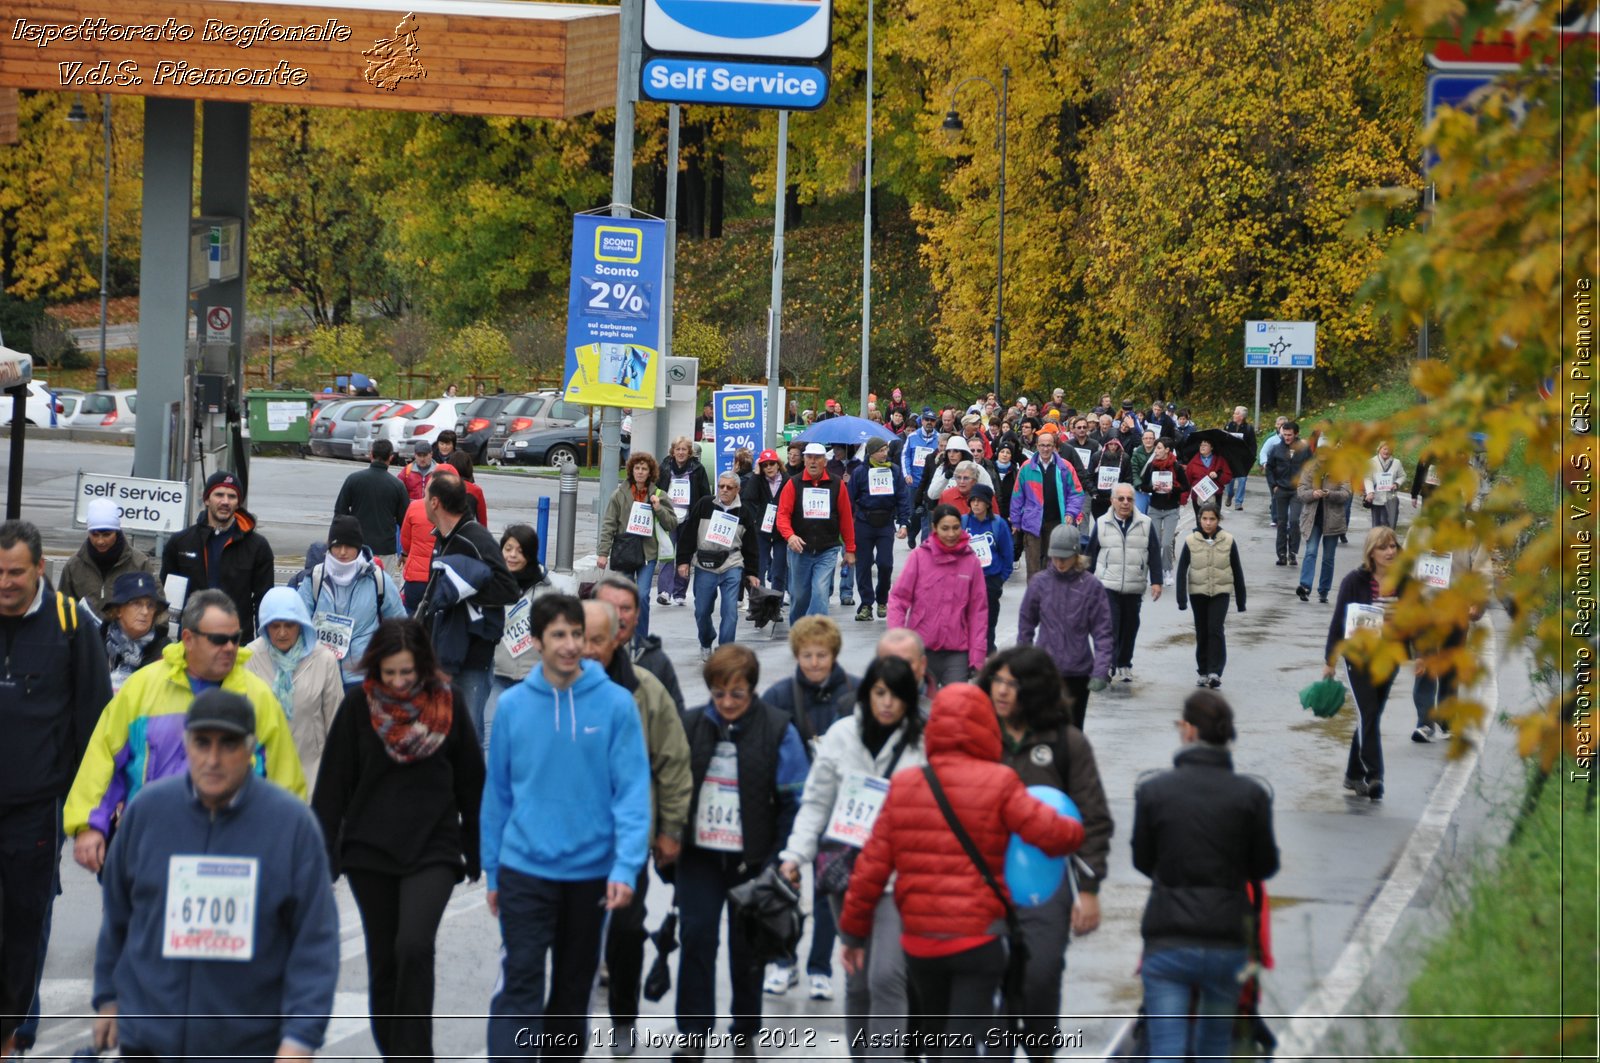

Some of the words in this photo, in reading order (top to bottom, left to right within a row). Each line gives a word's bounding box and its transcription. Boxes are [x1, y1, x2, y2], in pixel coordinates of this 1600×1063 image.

[650, 65, 706, 90] Self
[711, 68, 817, 96] Service
[603, 237, 634, 248] SCONTI
[595, 264, 639, 277] Sconto
[589, 281, 643, 312] 2%
[600, 323, 637, 331] carburante
[723, 421, 756, 430] Sconto
[723, 435, 755, 452] 2%
[84, 481, 116, 498] self
[120, 487, 182, 503] service
[316, 629, 344, 646] 12633
[182, 896, 236, 925] 6700
